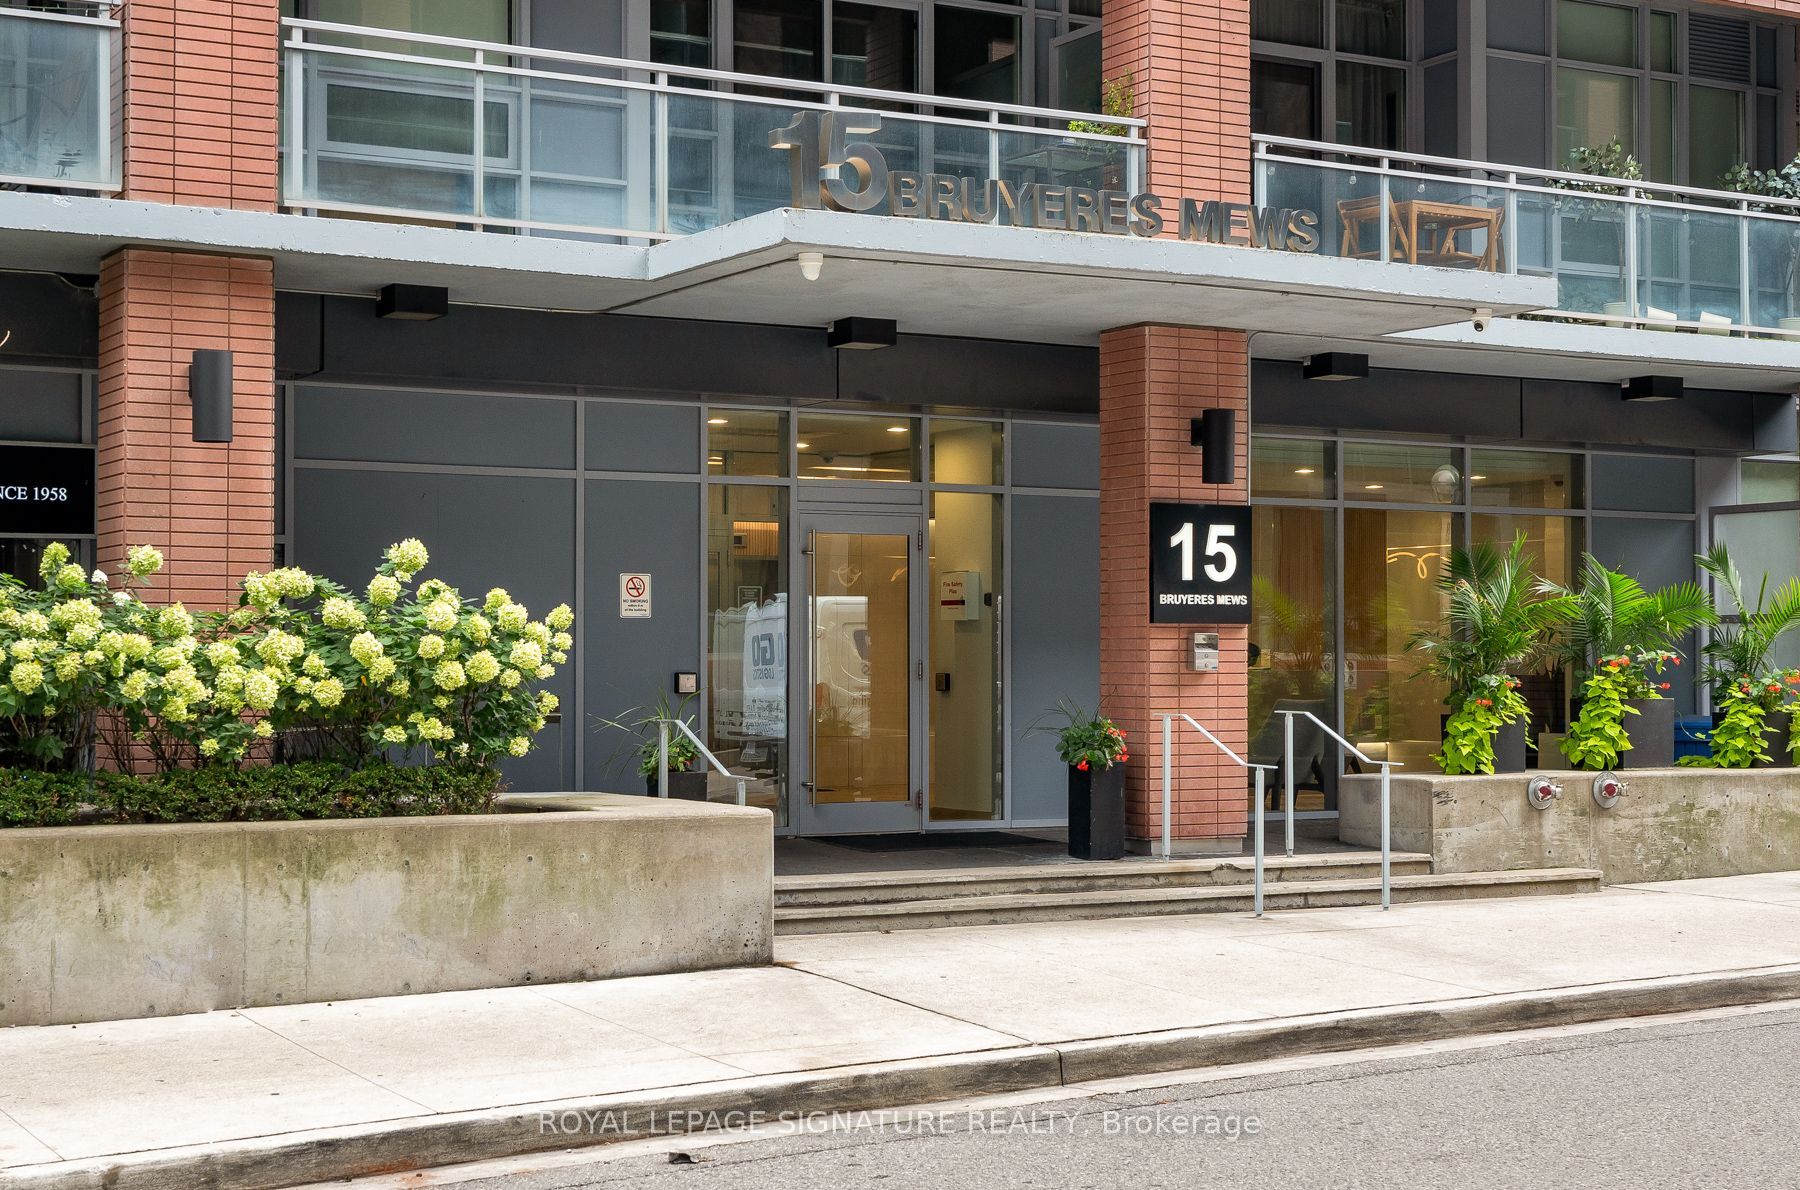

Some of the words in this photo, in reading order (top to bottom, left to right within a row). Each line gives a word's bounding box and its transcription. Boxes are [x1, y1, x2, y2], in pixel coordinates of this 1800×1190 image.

[768, 110, 889, 212] 15
[888, 170, 1163, 238] BRUYERES
[1178, 197, 1320, 253] MEWS
[33, 486, 68, 501] 1958
[1170, 522, 1237, 583] 15
[1159, 593, 1215, 605] BRUYERES
[1216, 594, 1248, 606] MEWS
